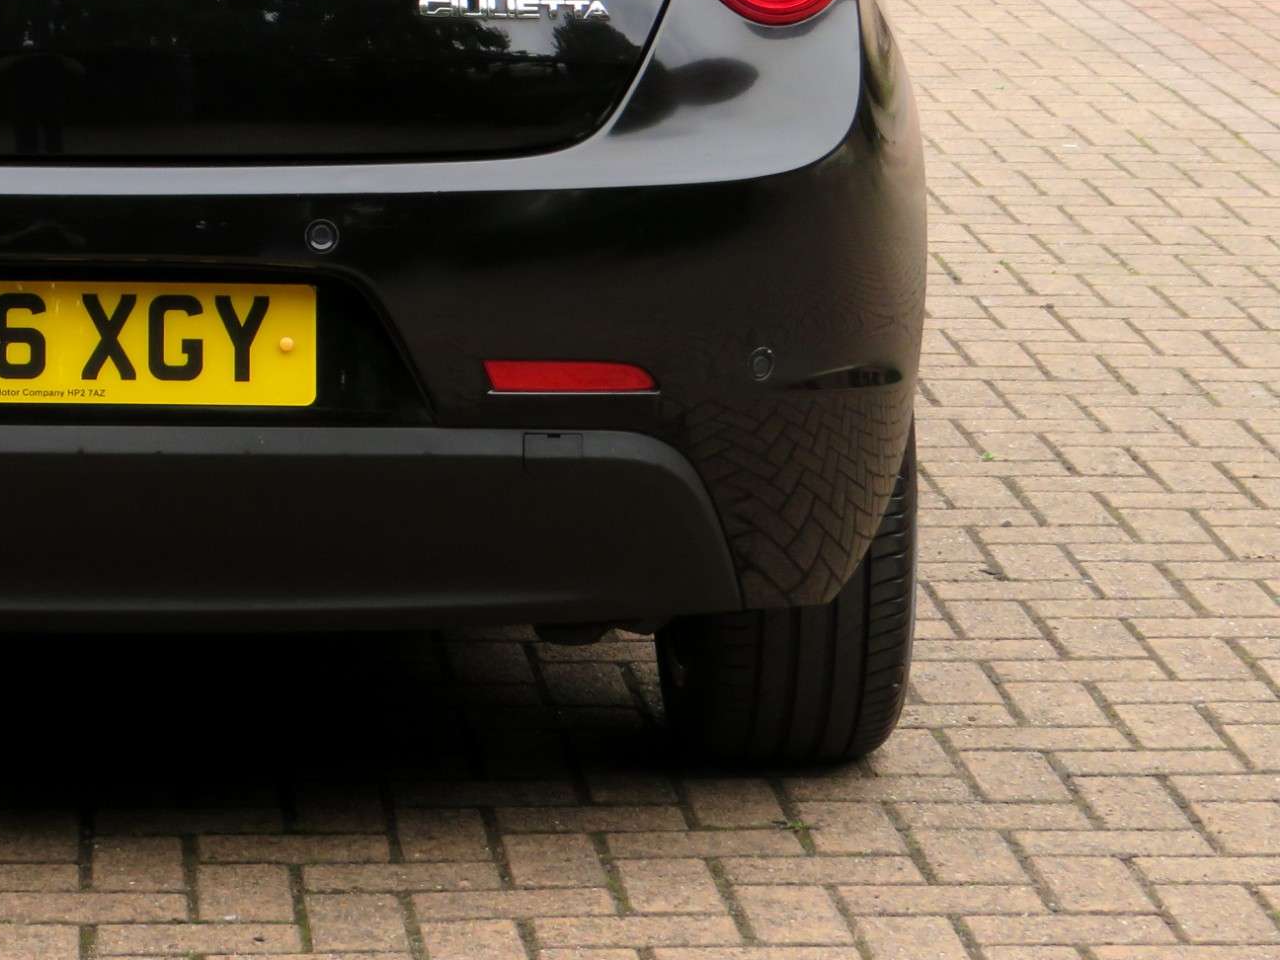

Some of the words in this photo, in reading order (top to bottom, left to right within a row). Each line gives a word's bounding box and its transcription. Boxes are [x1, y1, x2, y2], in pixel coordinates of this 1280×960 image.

[81, 294, 271, 382] XGY
[22, 388, 65, 399] Company
[67, 388, 86, 398] HP2
[88, 388, 106, 398] 7AZ
